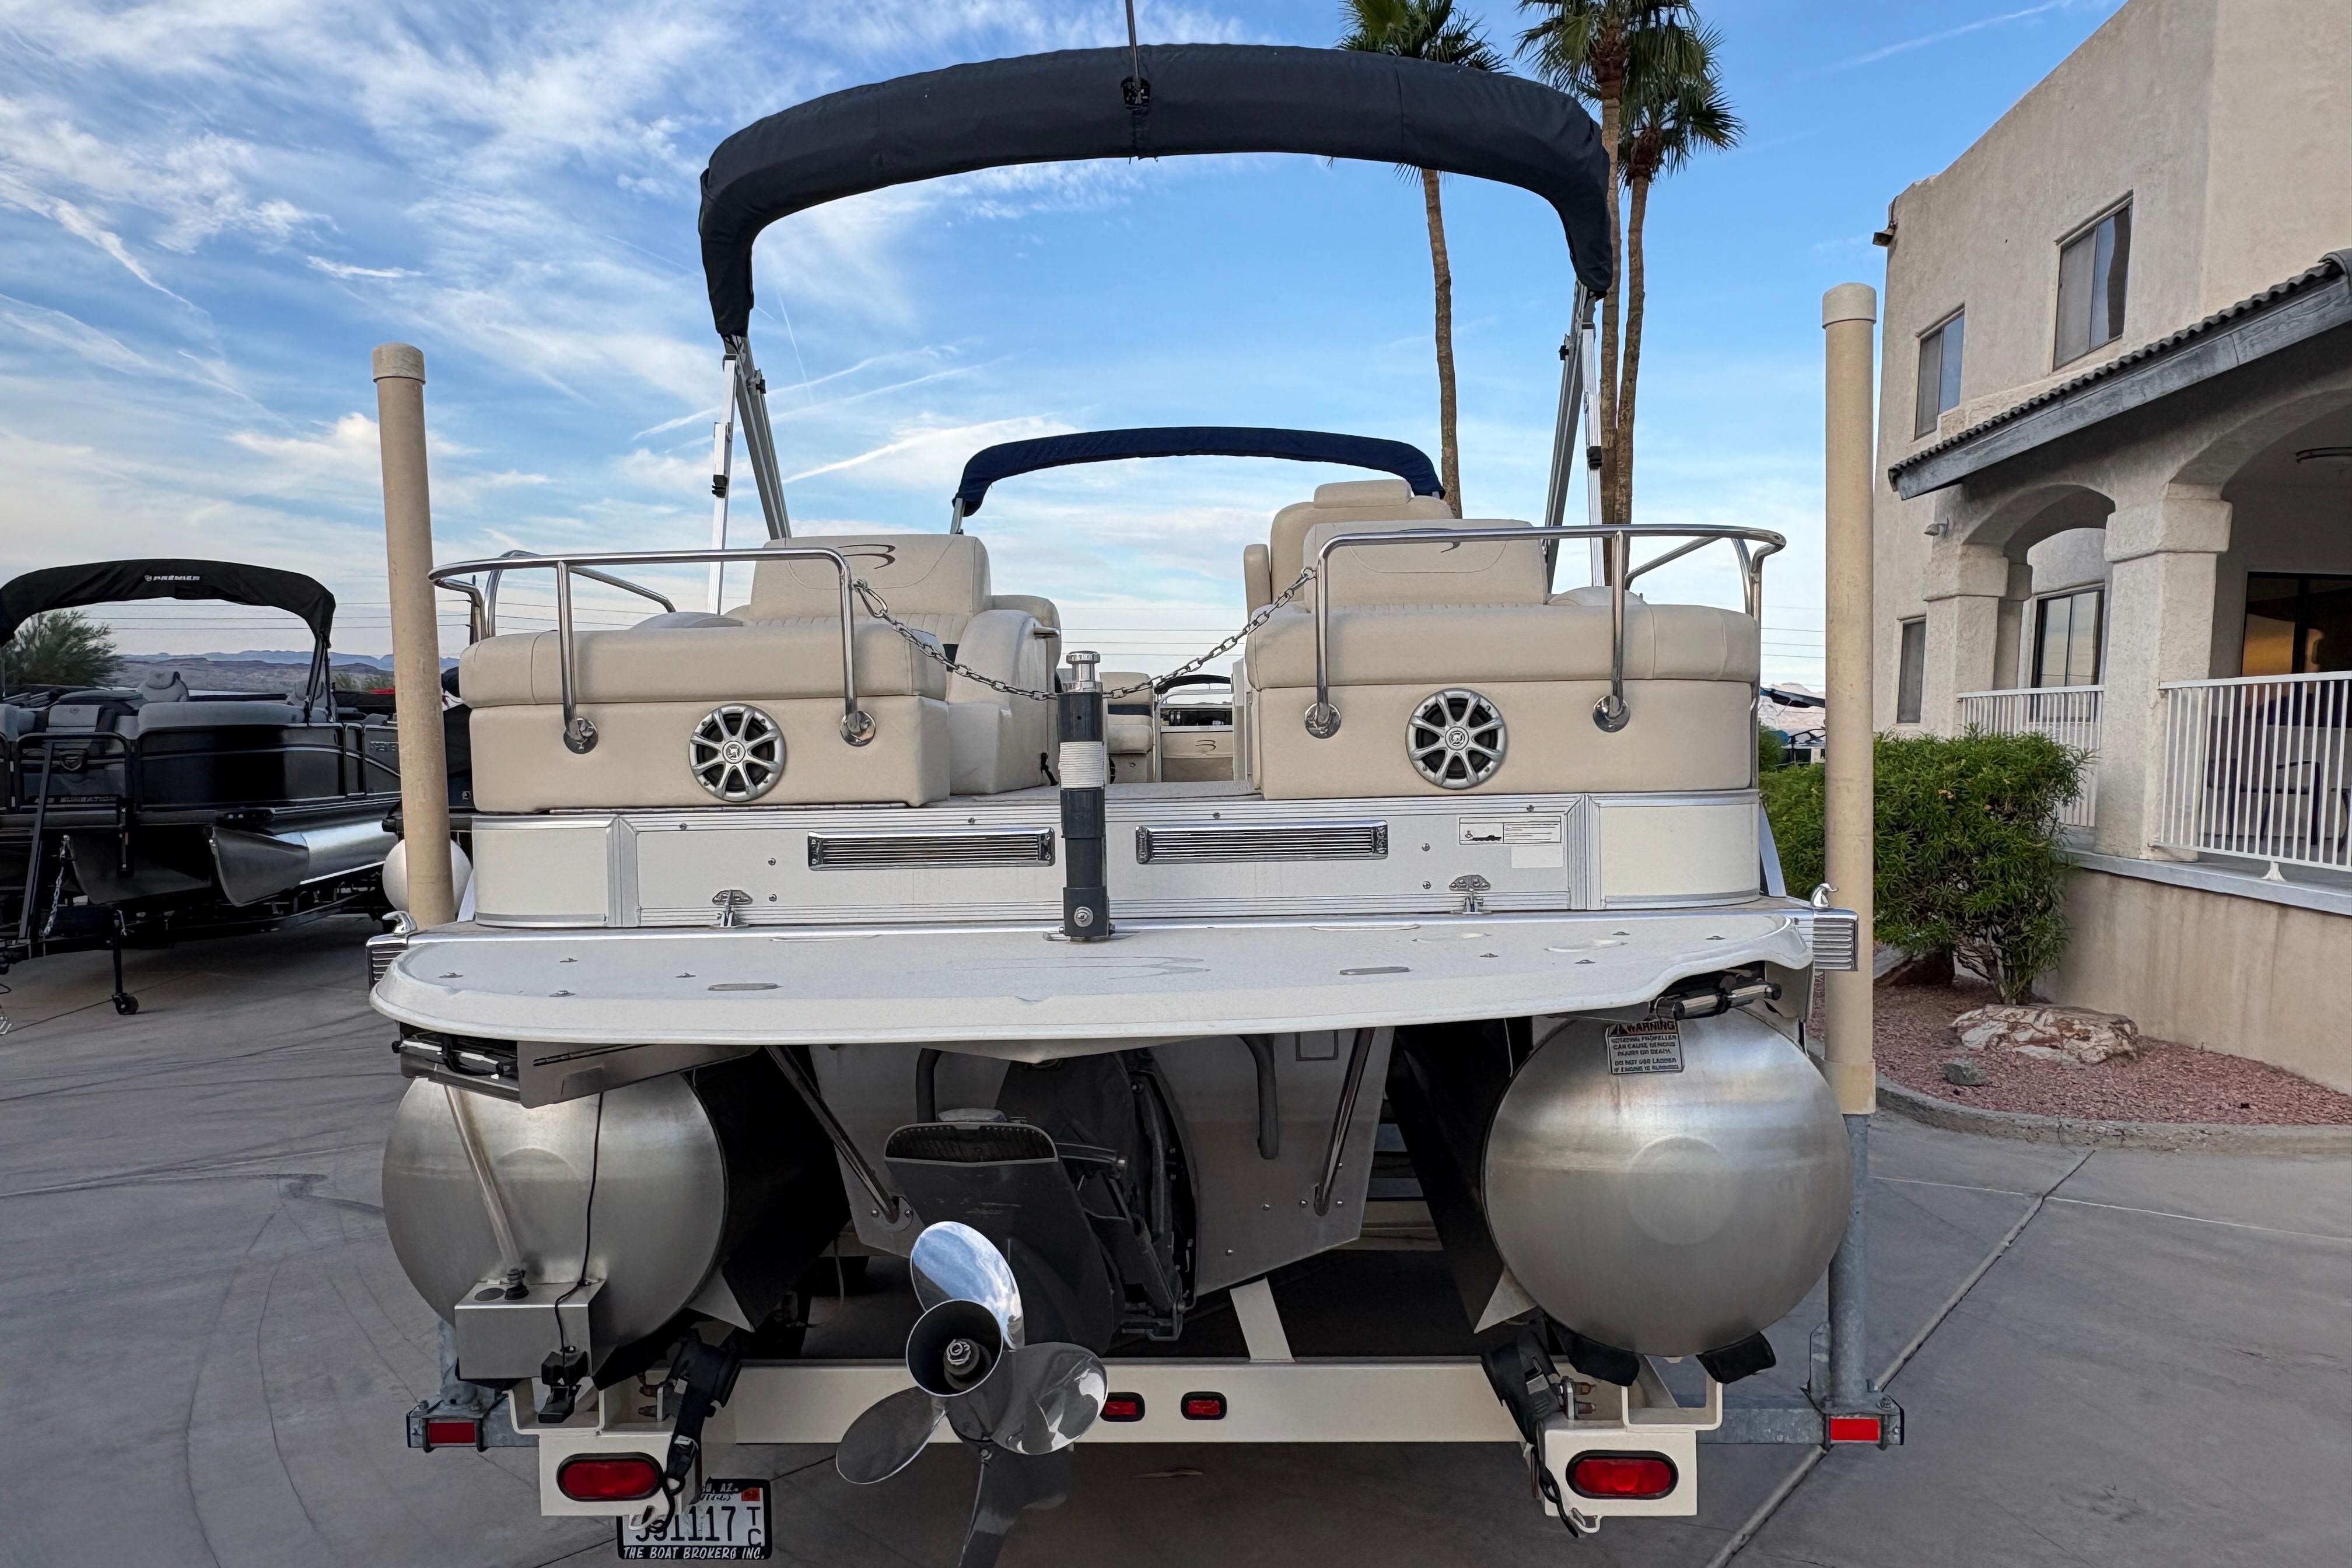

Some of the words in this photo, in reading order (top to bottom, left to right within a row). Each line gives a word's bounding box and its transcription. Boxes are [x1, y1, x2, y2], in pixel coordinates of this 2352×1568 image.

[1627, 1021, 1675, 1033] WARNING
[624, 1546, 644, 1559] THE
[650, 1546, 679, 1559] BOAT
[683, 1546, 736, 1559] BROKERS
[742, 1546, 765, 1559] INC.
